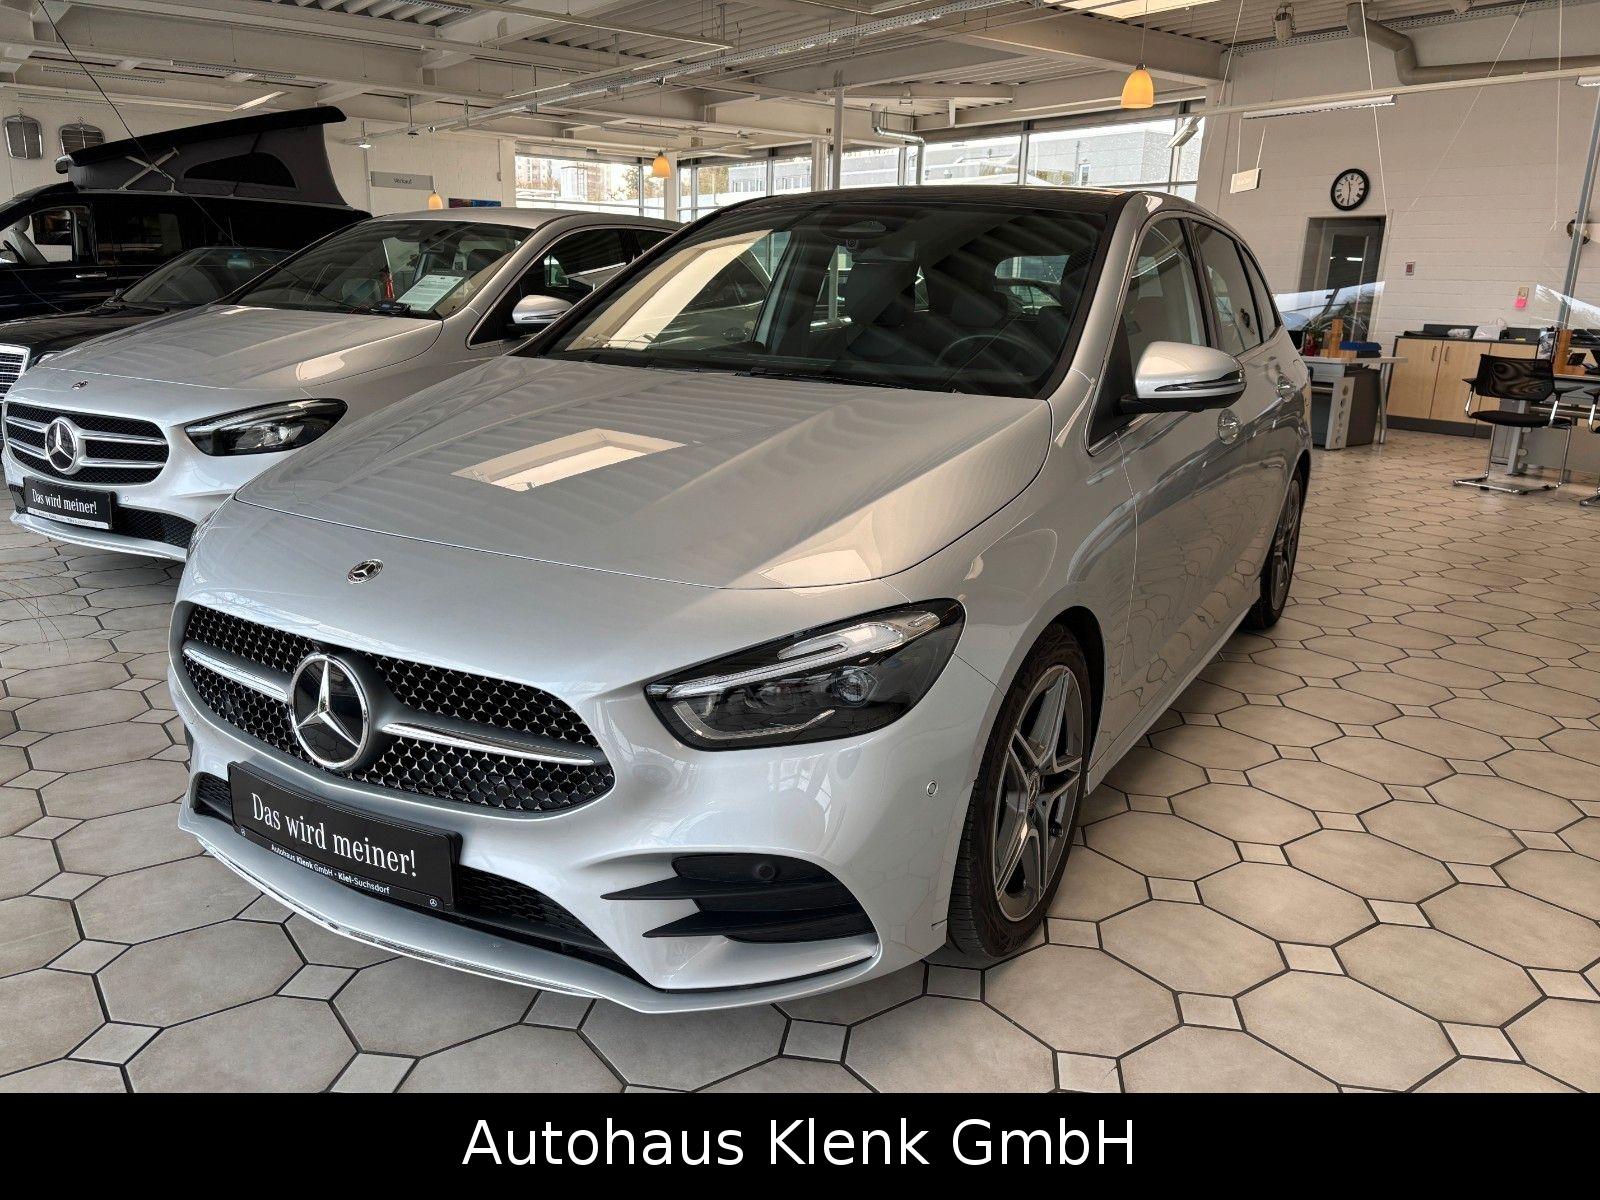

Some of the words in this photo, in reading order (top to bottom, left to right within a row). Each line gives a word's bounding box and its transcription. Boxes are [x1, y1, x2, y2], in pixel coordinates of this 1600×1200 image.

[32, 488, 44, 505] Das
[45, 493, 62, 509] wird
[63, 498, 97, 514] meiner!
[251, 792, 281, 831] Das
[284, 815, 327, 850] wird
[332, 833, 417, 877] meiner!
[271, 844, 296, 862] Autohaus
[296, 854, 313, 870] Klenk
[314, 863, 333, 877] GmbH
[338, 872, 390, 895] Kiel-Suchsdorf
